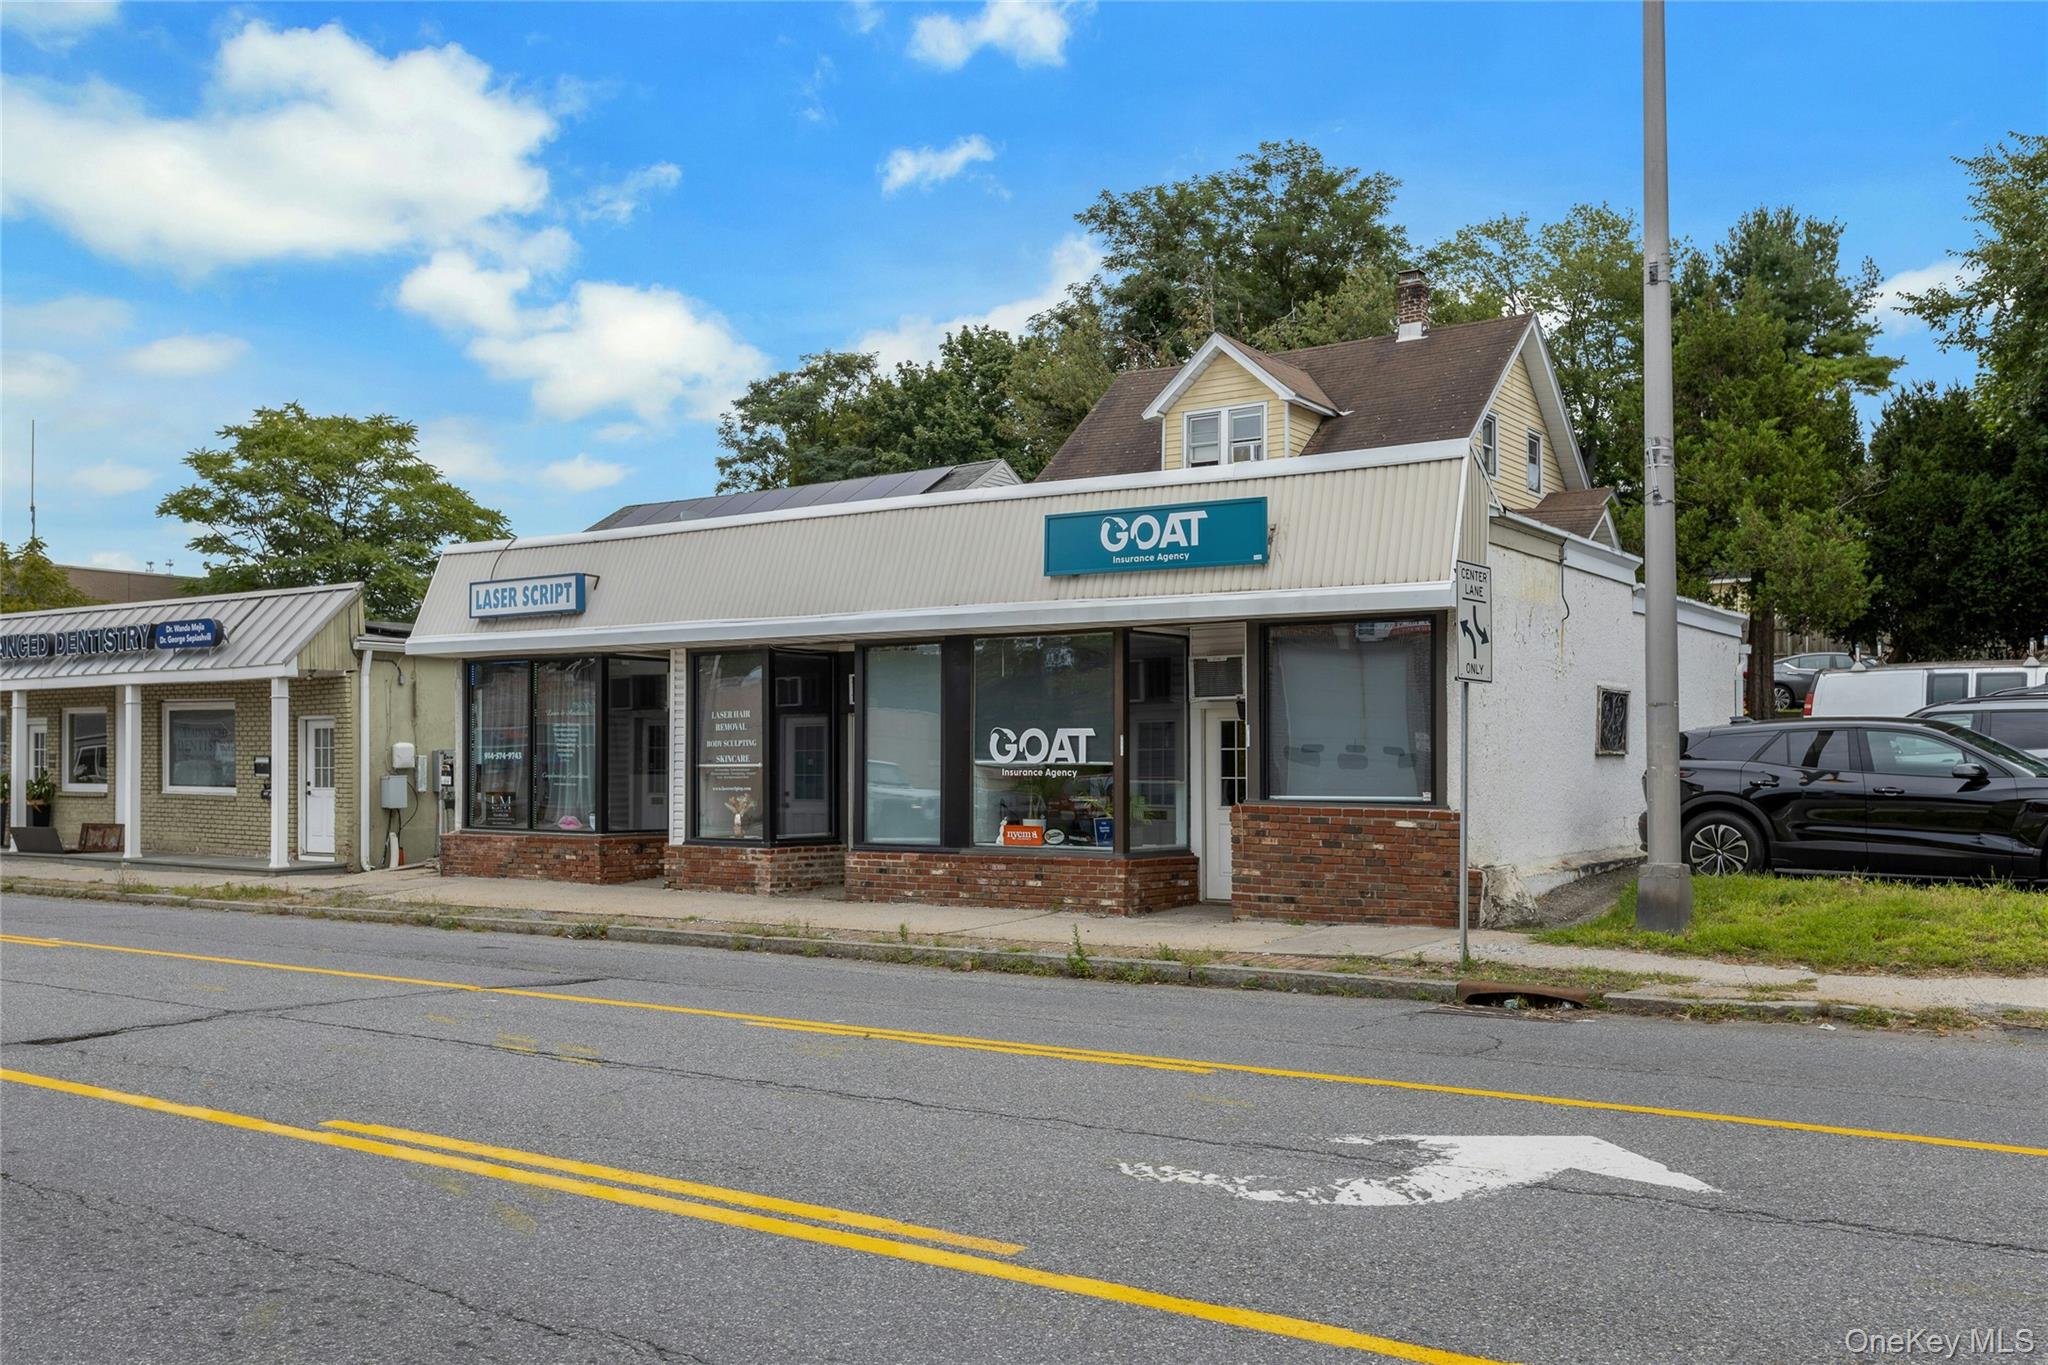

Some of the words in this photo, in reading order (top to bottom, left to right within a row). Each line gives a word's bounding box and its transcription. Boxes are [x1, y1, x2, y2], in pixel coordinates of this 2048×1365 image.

[1100, 510, 1208, 552] GOAT
[1112, 554, 1154, 564] Insurance
[1157, 553, 1189, 563] Agency
[1461, 567, 1487, 583] CENTER
[476, 587, 517, 609] LASER
[522, 582, 572, 607] SCRIPT
[1465, 583, 1483, 597] LANE
[55, 624, 150, 656] DENTISTRY
[168, 635, 185, 645] George
[1466, 662, 1484, 675] ONLY
[711, 711, 732, 719] LASER
[733, 710, 751, 718] HAIR
[715, 722, 747, 731] REMOVAL
[723, 739, 757, 747] SCULPTING
[989, 727, 1096, 764] GOAT
[716, 754, 751, 763] SKINCARE
[1002, 768, 1043, 777] Insurance
[1045, 768, 1077, 778] Agency
